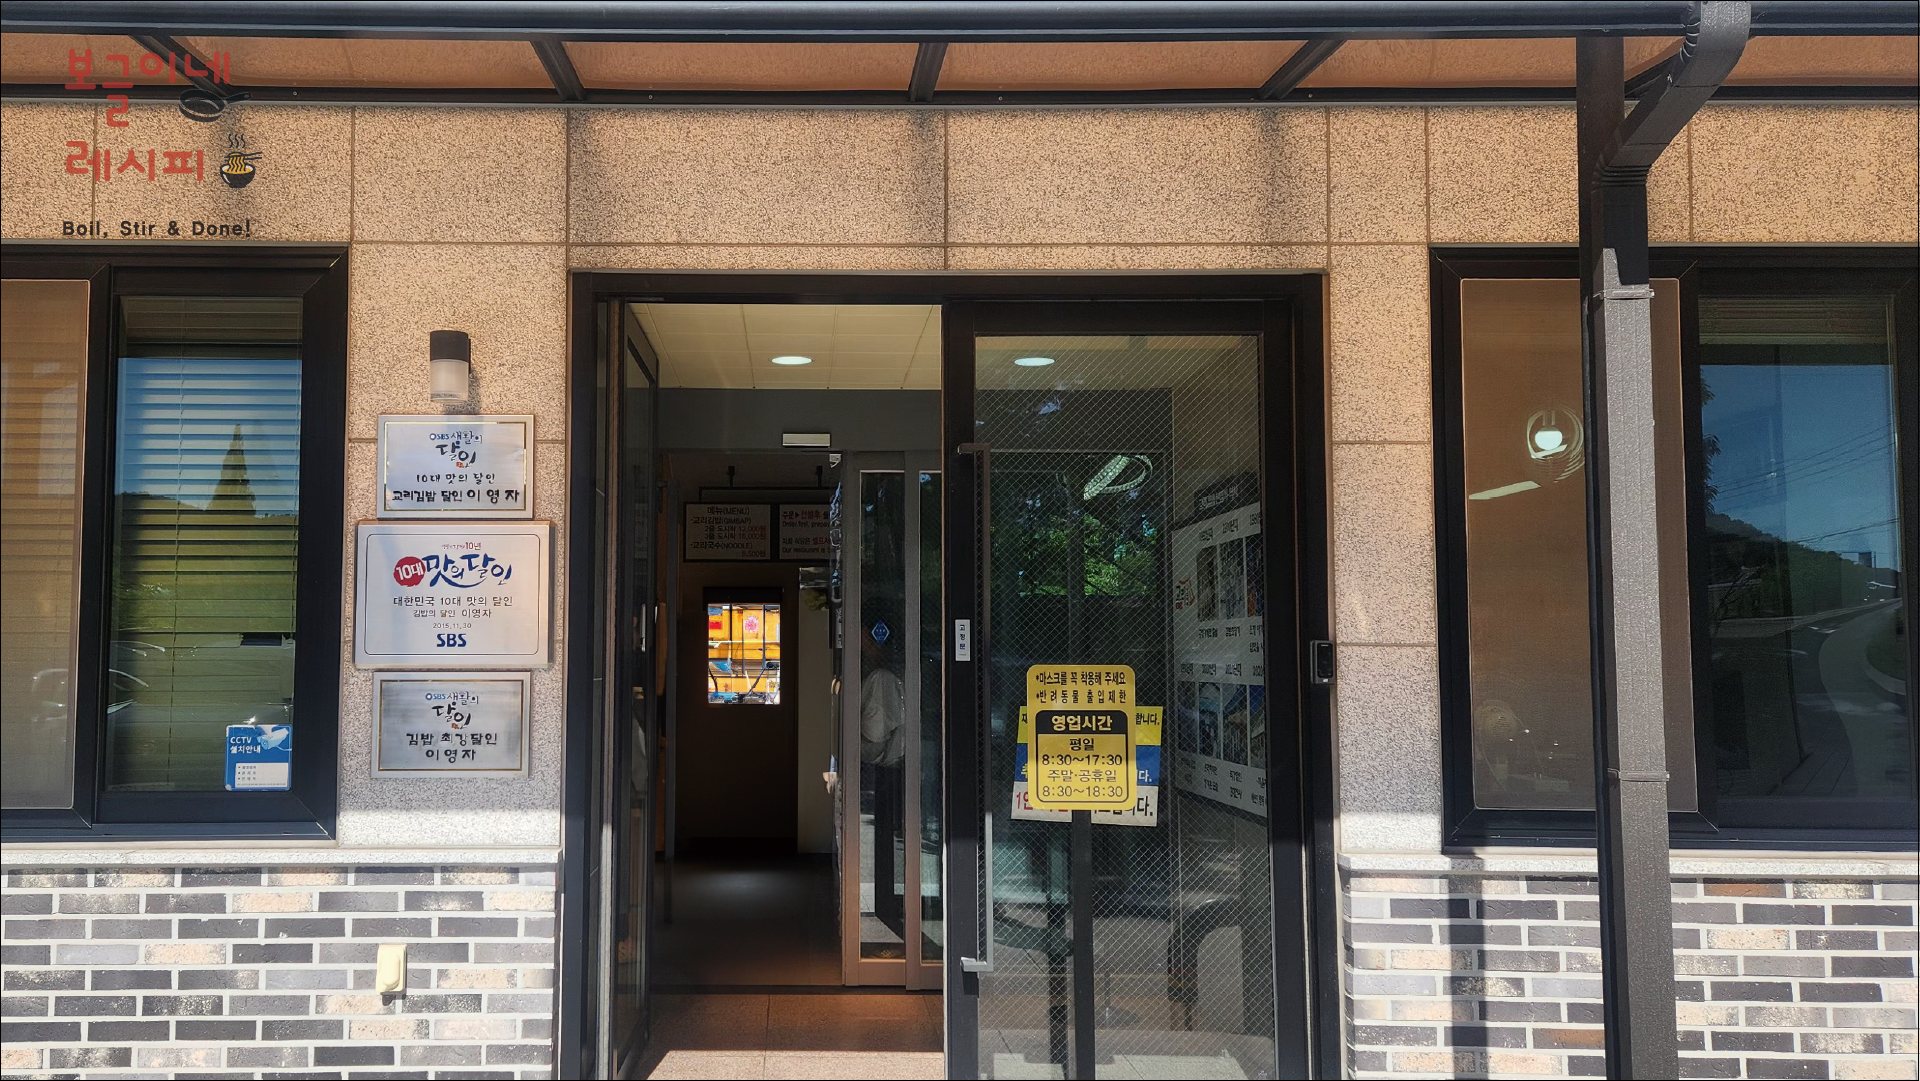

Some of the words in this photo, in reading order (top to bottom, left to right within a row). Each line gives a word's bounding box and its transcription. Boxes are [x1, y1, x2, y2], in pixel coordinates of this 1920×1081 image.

[416, 473, 441, 484] 10대
[445, 473, 468, 484] 맛의
[473, 472, 496, 485] 달인
[392, 490, 436, 502] 교리김밥
[441, 489, 463, 502] 달인
[395, 563, 424, 581] 10대
[423, 555, 464, 588] 맛의
[461, 553, 512, 586] 달인
[393, 596, 435, 606] 대한민국
[440, 596, 461, 606] 10대
[466, 596, 487, 606] 맛의
[492, 596, 513, 607] 달인
[413, 609, 436, 618] 김밥의
[440, 608, 456, 618] 달인
[461, 608, 492, 618] 이영자
[436, 633, 467, 648] SBS
[1070, 672, 1078, 686] 꼭
[1081, 671, 1102, 686] 착용해
[1104, 671, 1127, 685] 주세요
[1051, 714, 1113, 732] 영업시간
[230, 736, 252, 744] CCTV
[406, 733, 435, 746] 김밥
[440, 732, 498, 746] 최강달인
[1069, 738, 1095, 751] 평일
[230, 745, 261, 754] 설치안내
[425, 749, 476, 764] 이영자
[1041, 754, 1123, 766] 8:30~17:30
[1042, 785, 1123, 798] 8:30~18:30
